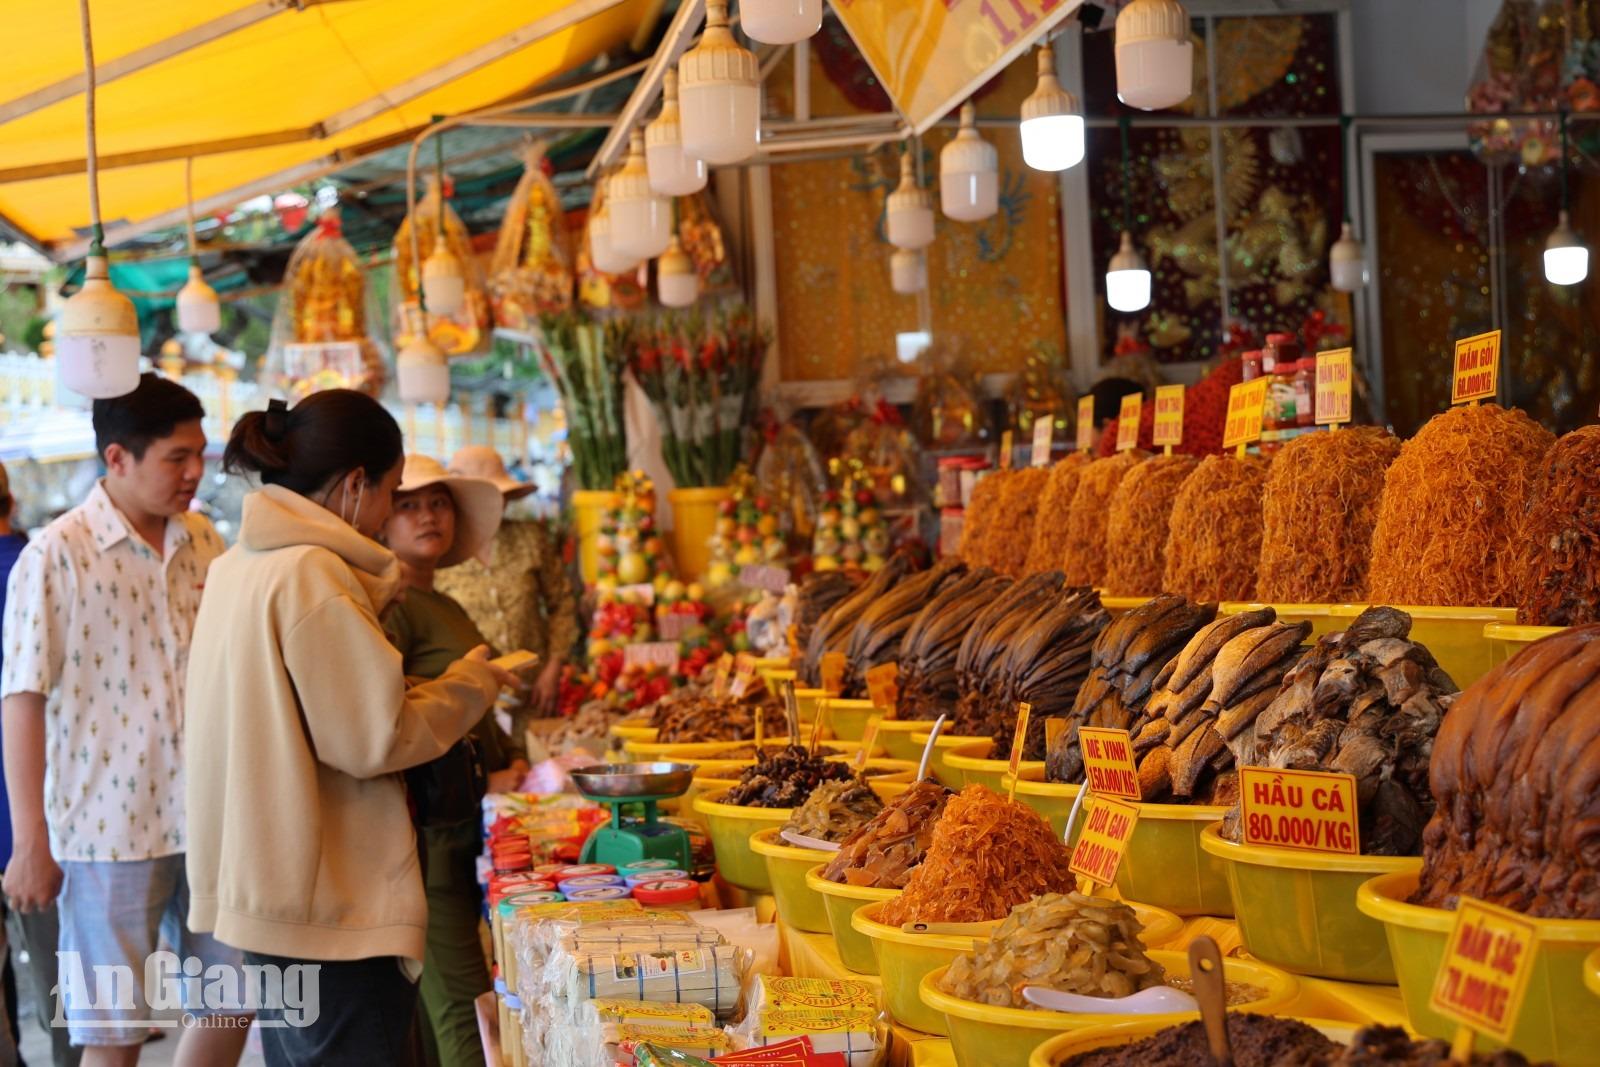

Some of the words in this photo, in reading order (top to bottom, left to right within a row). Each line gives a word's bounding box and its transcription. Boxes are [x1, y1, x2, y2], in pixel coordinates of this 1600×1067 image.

[1103, 740, 1127, 762] VINH
[1089, 766, 1136, 795] 150.000/KG
[1253, 775, 1303, 808] HẦU
[1311, 784, 1344, 812] CÁ
[1107, 813, 1130, 841] GAN
[1249, 812, 1352, 850] 80.000/KG
[1073, 839, 1119, 881] 60.000/KG
